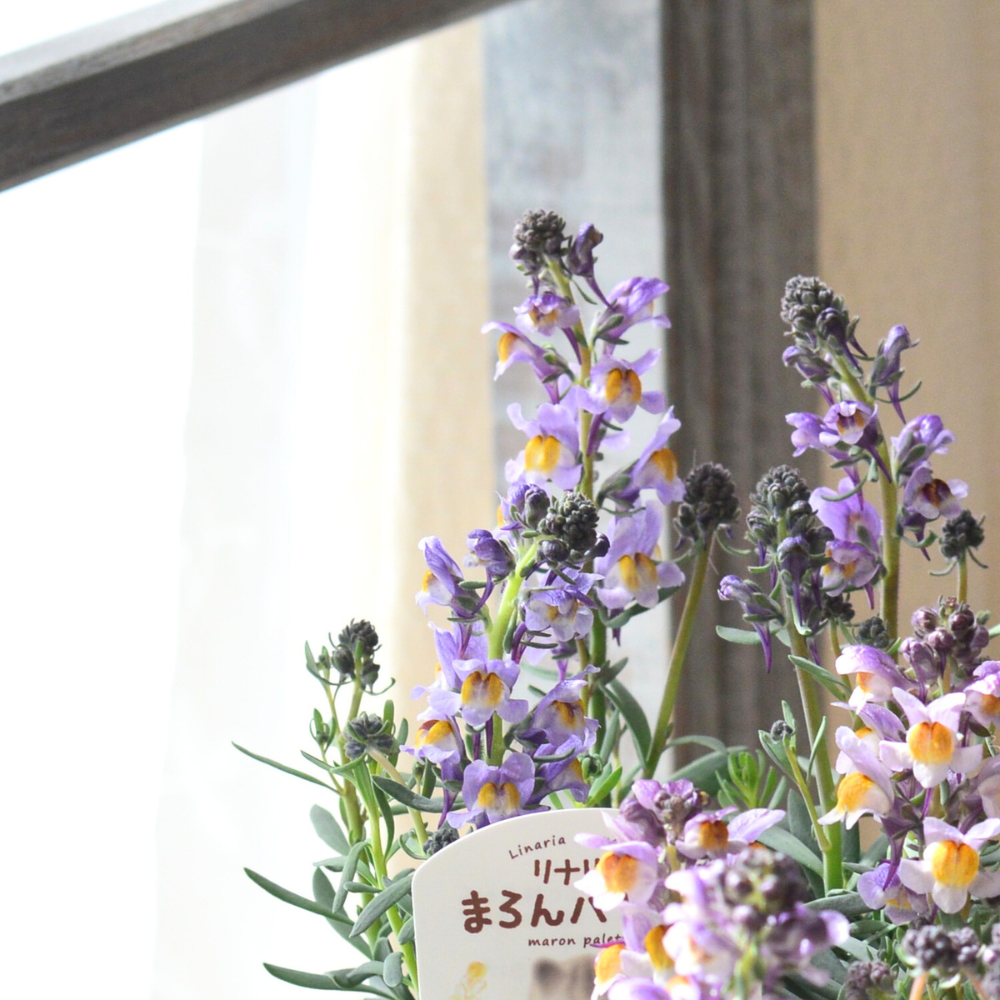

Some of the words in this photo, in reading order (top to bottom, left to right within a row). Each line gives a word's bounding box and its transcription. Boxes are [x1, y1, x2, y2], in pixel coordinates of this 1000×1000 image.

[508, 834, 566, 860] Linaria
[528, 936, 576, 947] maron
[583, 932, 625, 949] palet
